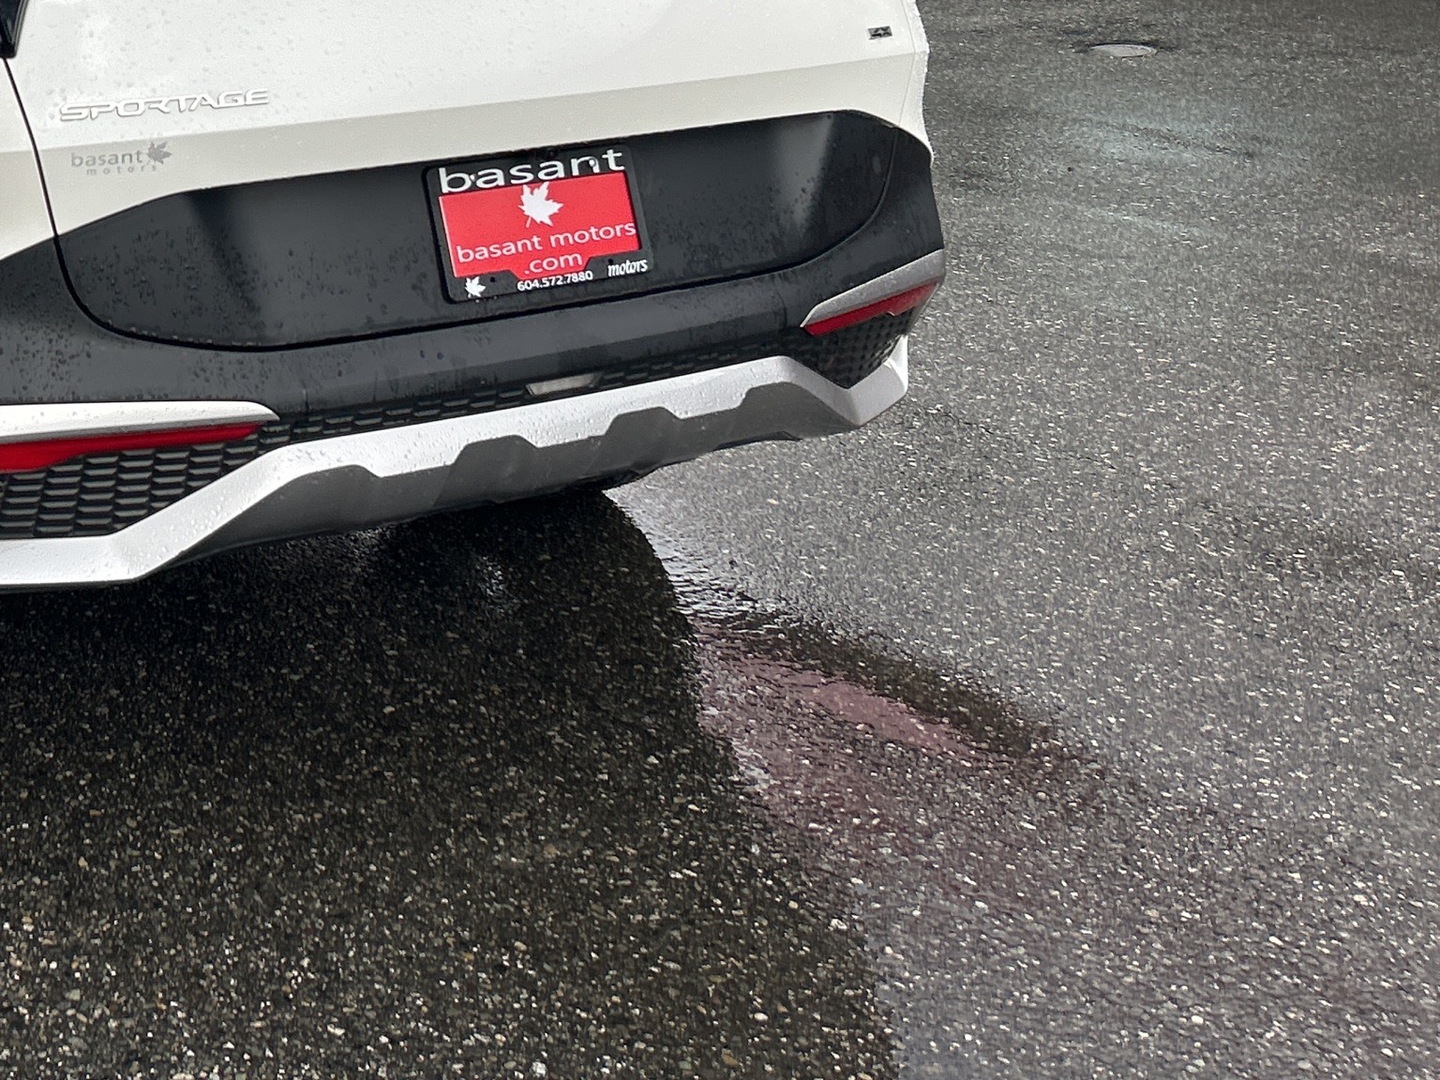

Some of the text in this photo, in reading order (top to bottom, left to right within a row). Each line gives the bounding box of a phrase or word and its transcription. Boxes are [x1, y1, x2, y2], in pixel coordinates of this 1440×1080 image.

[60, 88, 270, 122] SPORTAGE
[71, 149, 143, 168] basant
[86, 164, 158, 176] motors
[439, 148, 625, 194] basant
[456, 222, 637, 263] basant motors
[524, 252, 583, 275] .com
[607, 258, 648, 277] motors
[517, 270, 594, 292] 604.572.7880
